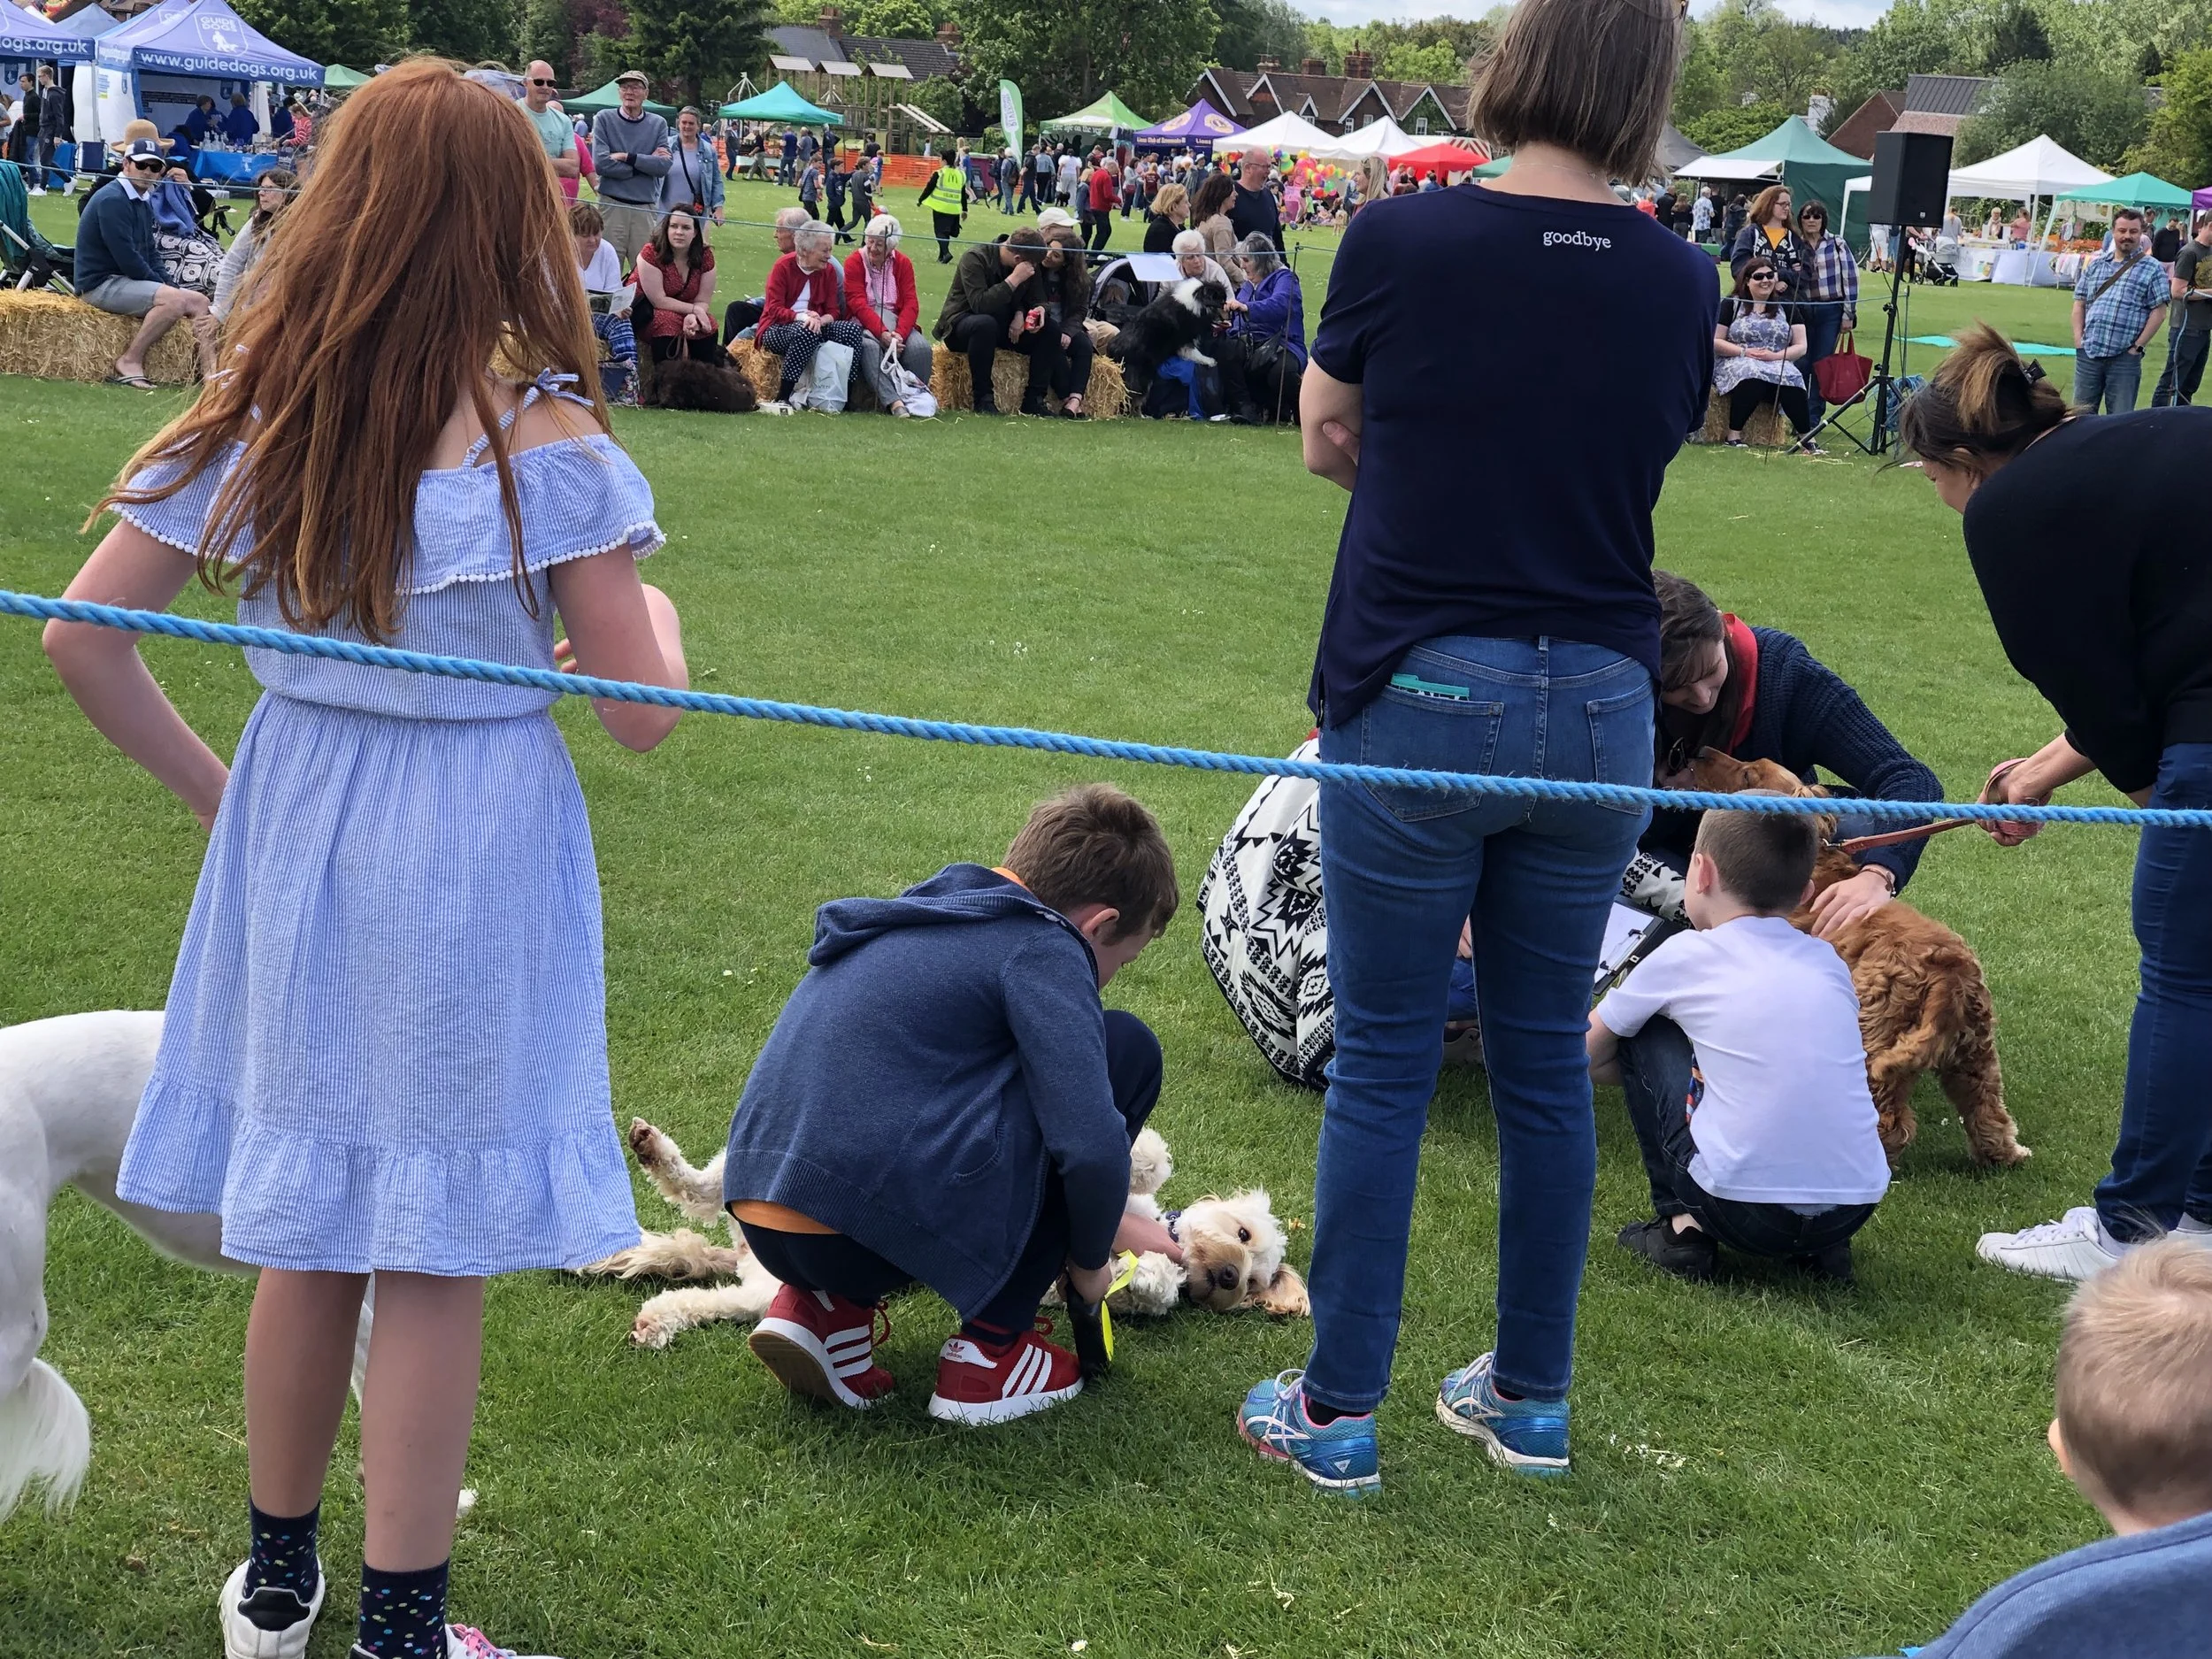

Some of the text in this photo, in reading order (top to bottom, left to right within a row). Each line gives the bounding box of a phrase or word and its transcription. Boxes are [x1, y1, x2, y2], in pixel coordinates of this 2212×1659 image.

[201, 16, 235, 26] GUIDE
[202, 23, 237, 33] DOGS
[0, 38, 88, 54] ogs.org.uk
[141, 52, 318, 81] www.guidedogs.org.uk
[146, 140, 156, 151] D
[1543, 231, 1611, 251] goodbye
